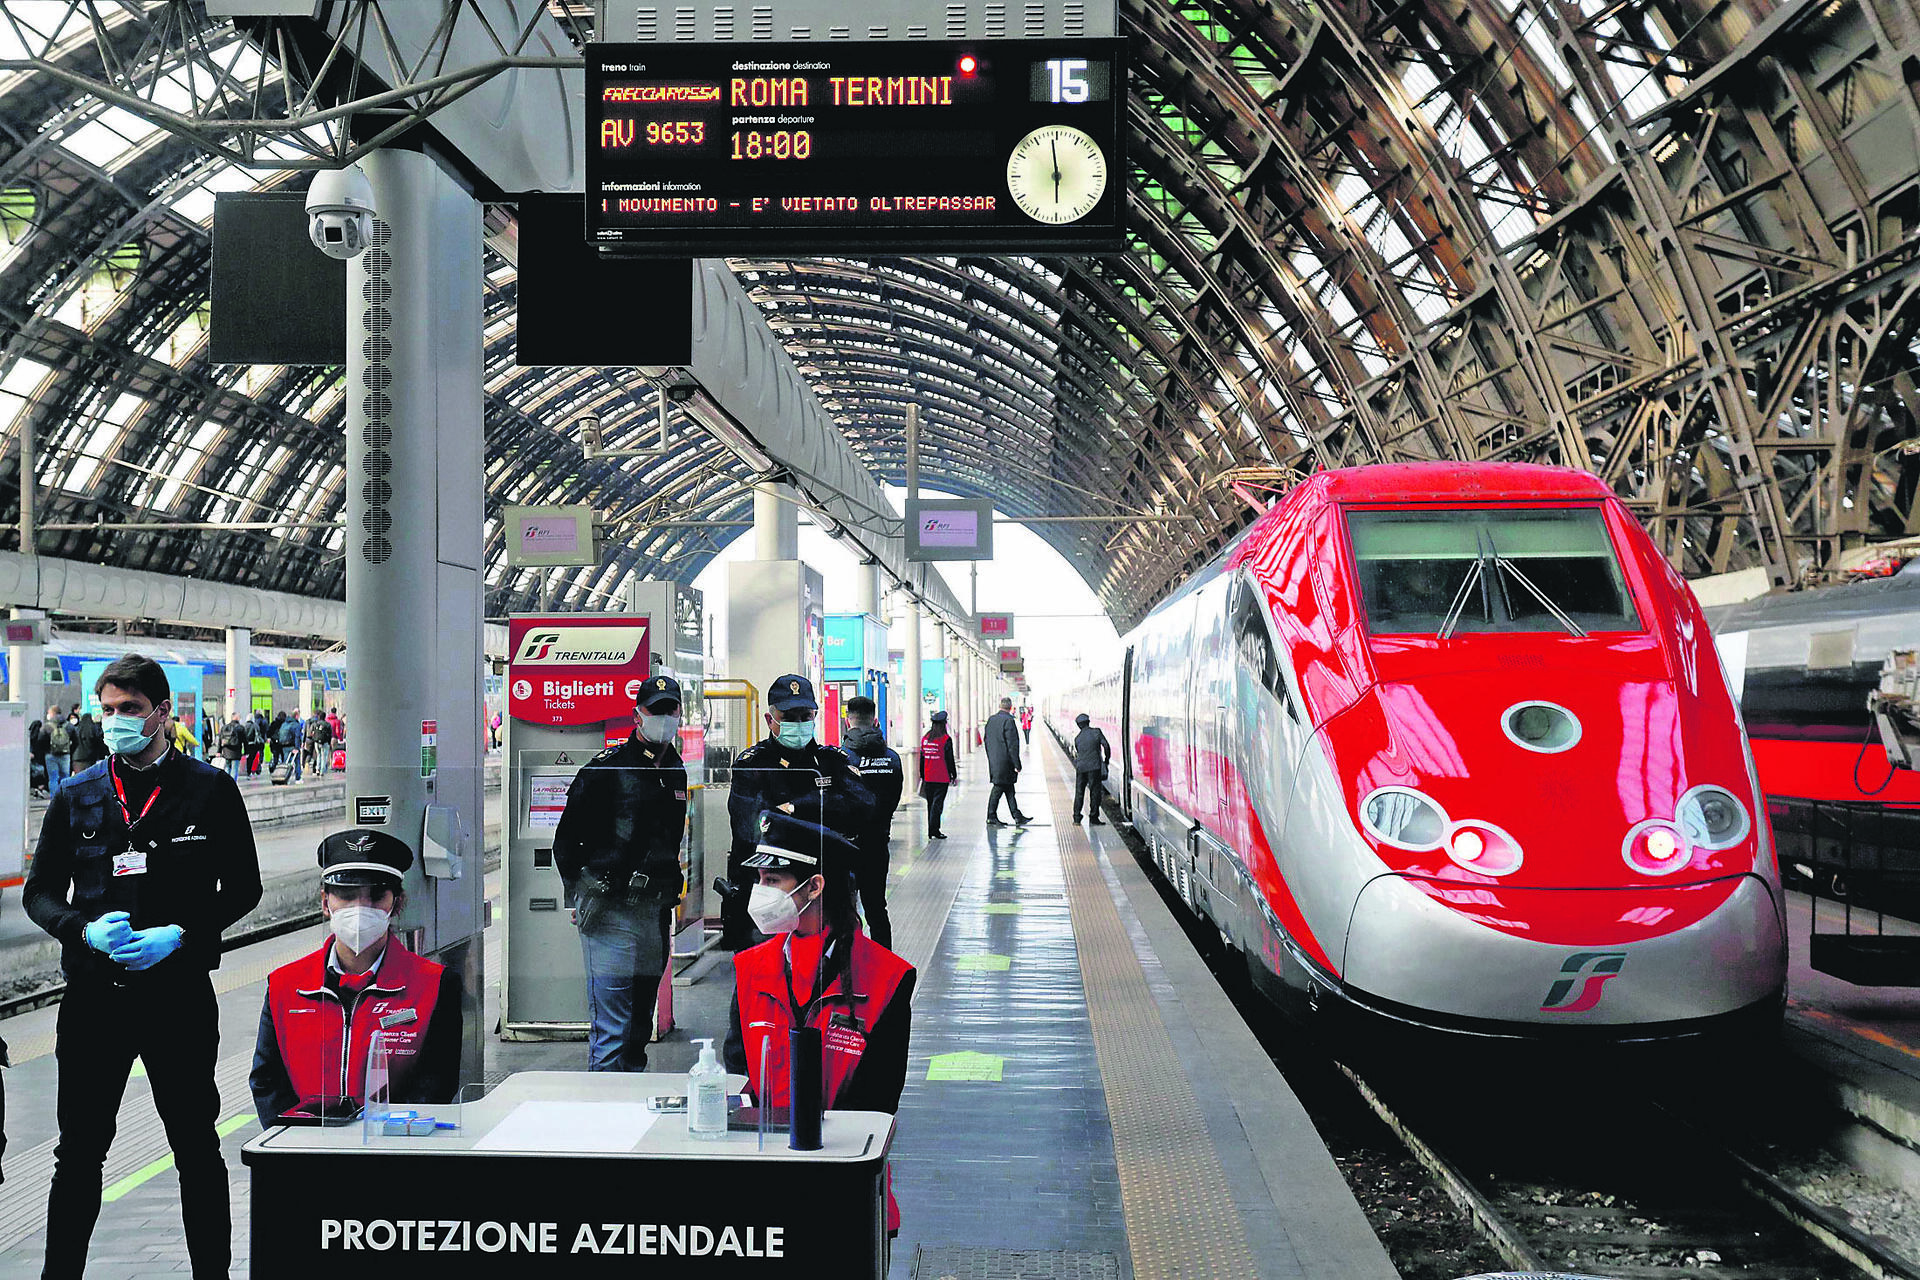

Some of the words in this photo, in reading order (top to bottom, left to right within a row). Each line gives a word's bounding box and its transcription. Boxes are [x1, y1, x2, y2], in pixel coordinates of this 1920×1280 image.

[601, 63, 627, 72] treno
[629, 63, 646, 72] train
[732, 60, 791, 70] destinazione
[792, 60, 831, 70] destination
[1045, 59, 1090, 104] 15
[731, 77, 809, 106] ROMA
[829, 76, 952, 106] TERMINI
[731, 115, 776, 126] partenza
[777, 114, 815, 125] departure
[601, 119, 635, 147] AV
[646, 121, 705, 144] 9653
[731, 130, 811, 159] 18:00
[601, 181, 661, 191] informazioni
[662, 181, 702, 191] information
[619, 197, 718, 212] MOVIMENTO
[781, 196, 859, 211] VIETATO
[870, 196, 997, 211] OLTREPASSAR
[827, 635, 847, 646] Bar
[554, 651, 626, 661] TRENITALIA
[543, 680, 614, 699] Biglietti
[543, 699, 576, 709] Tickets
[360, 807, 387, 816] EXIT
[321, 1219, 558, 1254] PROTEZIONE
[570, 1223, 785, 1258] AZIENDALE
